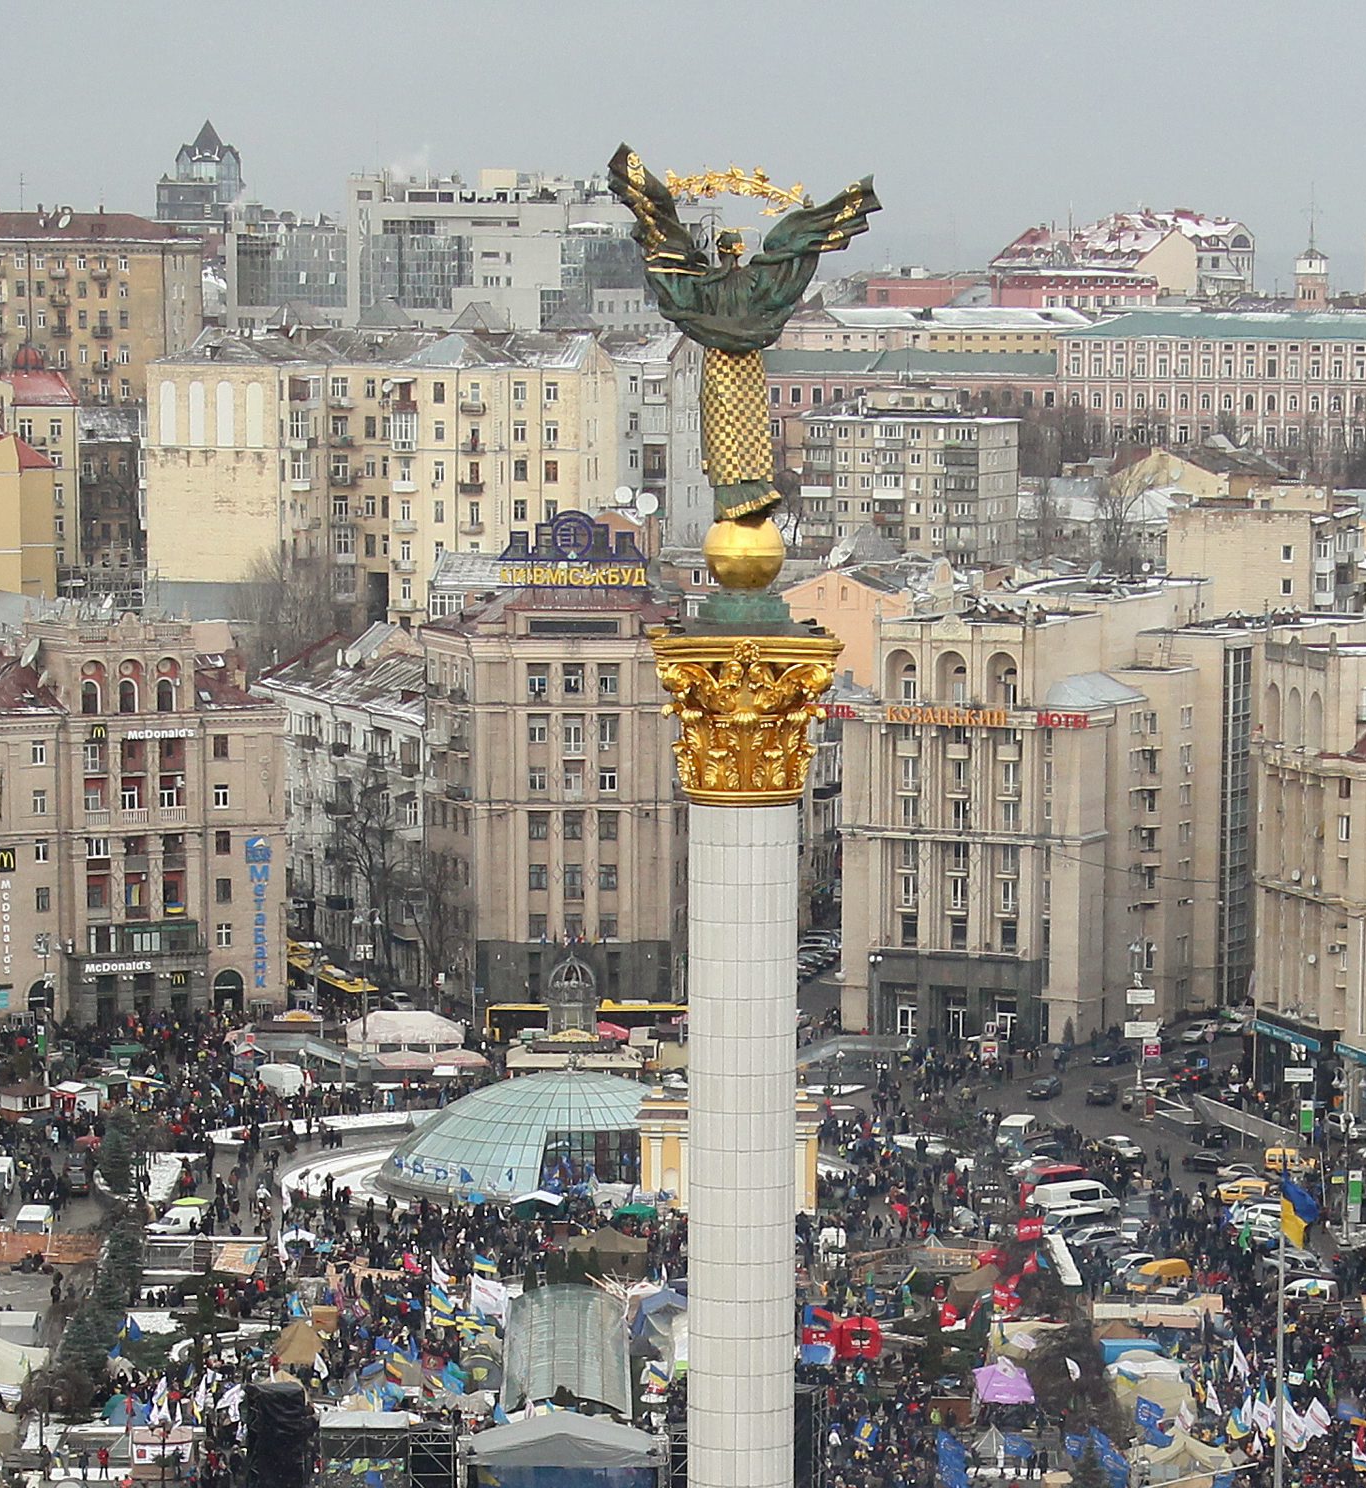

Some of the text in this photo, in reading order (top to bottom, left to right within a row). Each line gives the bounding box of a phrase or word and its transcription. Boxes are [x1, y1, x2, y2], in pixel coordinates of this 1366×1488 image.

[886, 706, 1007, 729] КОЗАЦЬКИЙ
[127, 727, 195, 740] McDonald's
[1, 879, 13, 975] McDonald's
[85, 960, 152, 973] McDonald's
